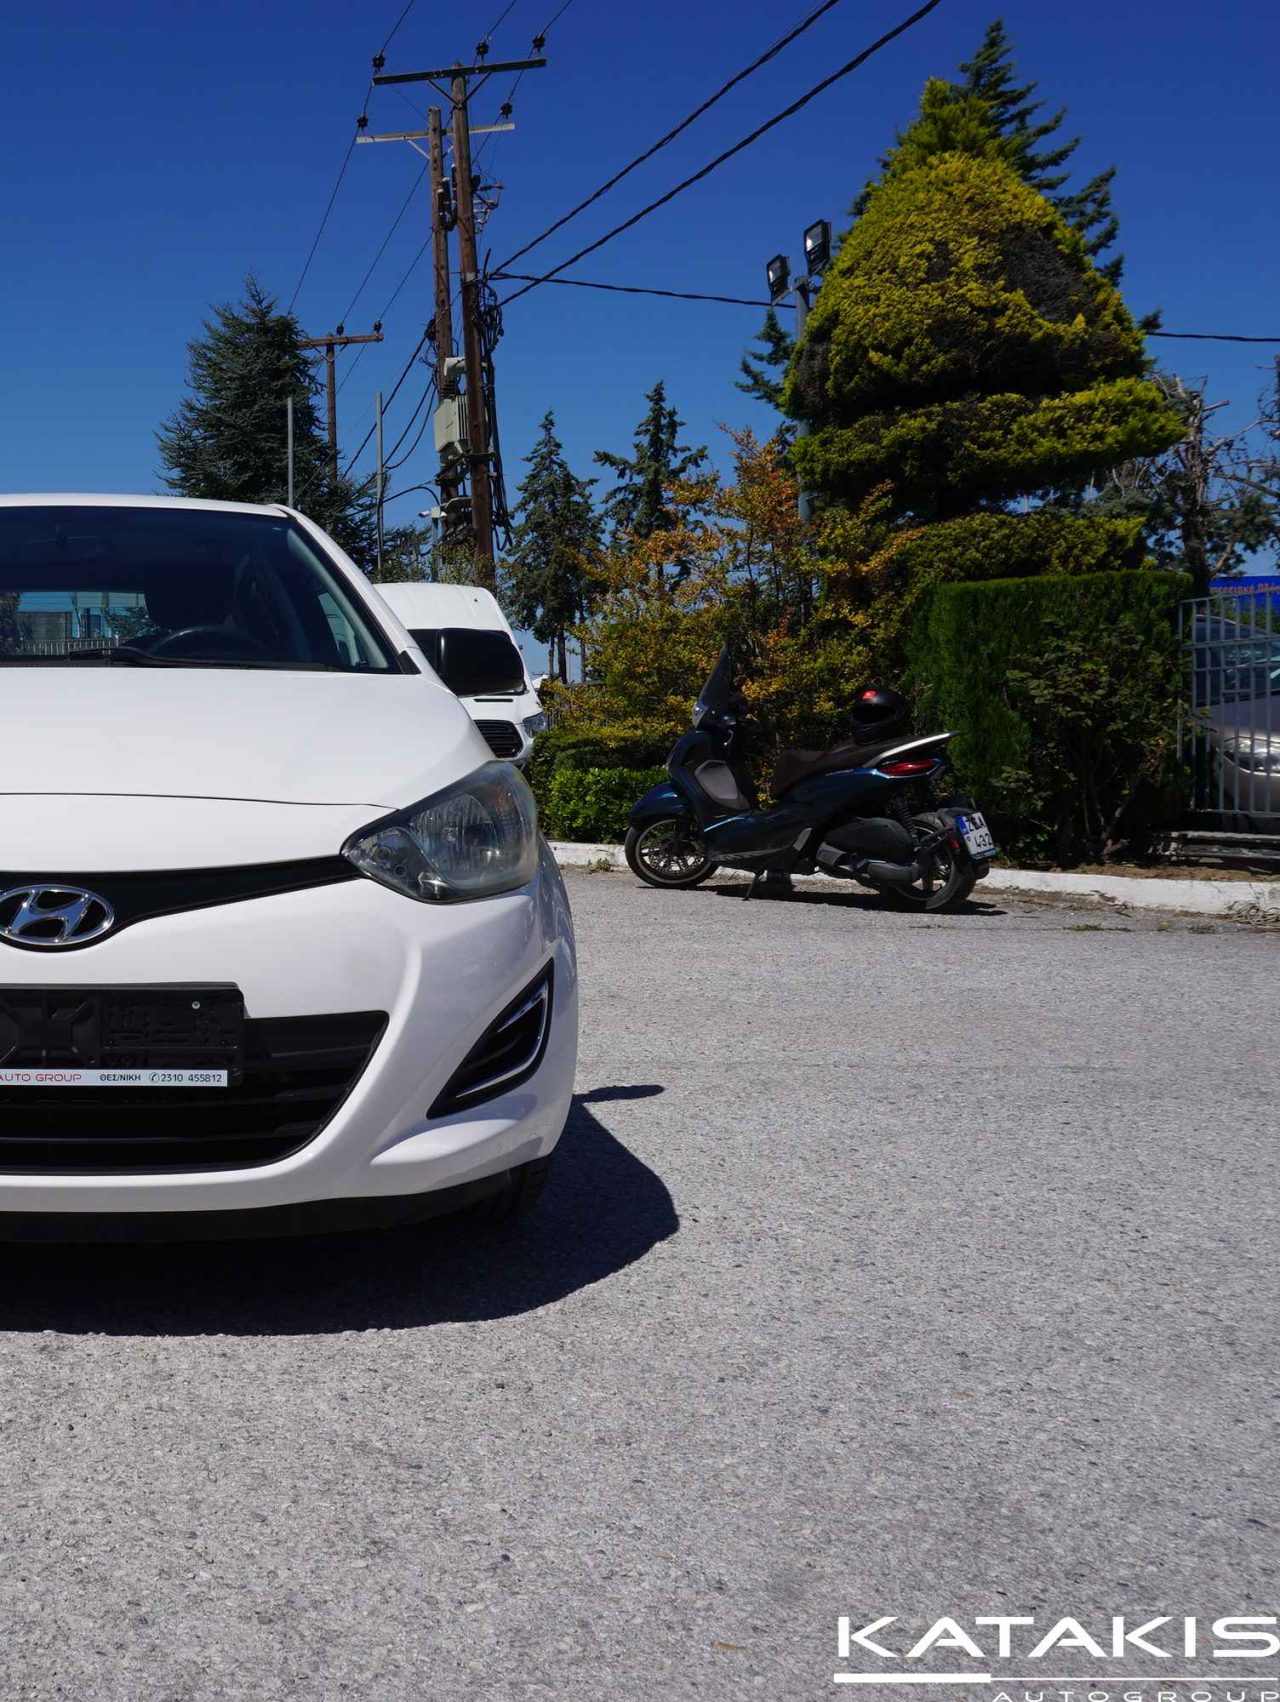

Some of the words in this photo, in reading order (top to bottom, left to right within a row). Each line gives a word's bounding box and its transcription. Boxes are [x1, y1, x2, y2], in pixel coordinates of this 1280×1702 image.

[35, 1073, 82, 1082] GROUP
[99, 1073, 141, 1082] ΘΕΣ/ΝΙΚΗ
[160, 1073, 184, 1083] 2310
[187, 1073, 223, 1083] 455812
